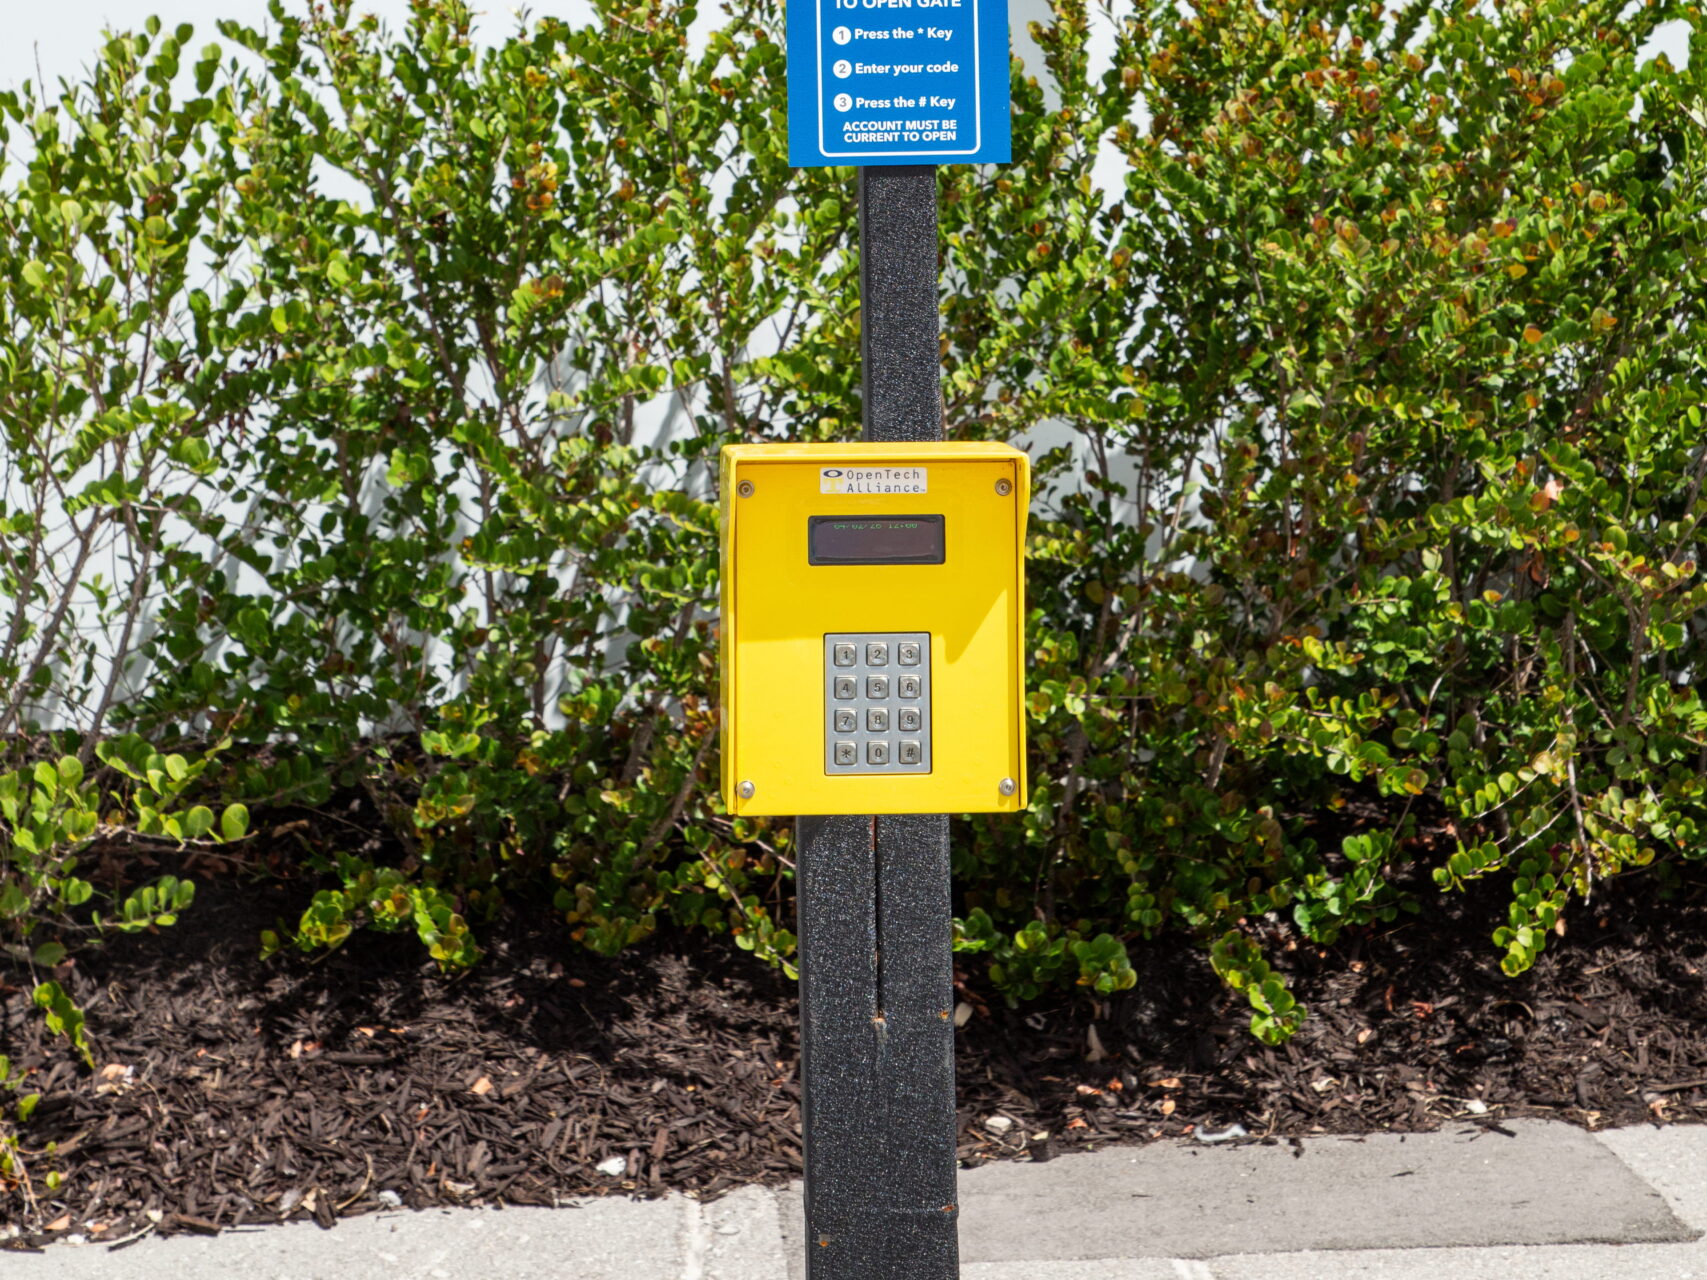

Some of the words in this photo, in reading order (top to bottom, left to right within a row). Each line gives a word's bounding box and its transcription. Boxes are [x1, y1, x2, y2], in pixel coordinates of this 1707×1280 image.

[854, 29, 889, 40] Press
[892, 28, 914, 39] the
[927, 27, 953, 41] Key
[856, 63, 890, 74] Enter
[893, 63, 923, 76] your
[927, 61, 959, 73] code
[856, 98, 890, 108] Press
[894, 96, 915, 108] the
[919, 97, 927, 107] #
[930, 96, 955, 110] Key
[843, 121, 903, 132] ACCOUNT
[906, 120, 939, 130] MUST
[942, 120, 957, 130] BE
[844, 132, 900, 143] CURRENT
[902, 132, 919, 141] TO
[922, 131, 956, 141] OPEN
[847, 470, 920, 481] OpenTech
[847, 482, 920, 492] Alliance
